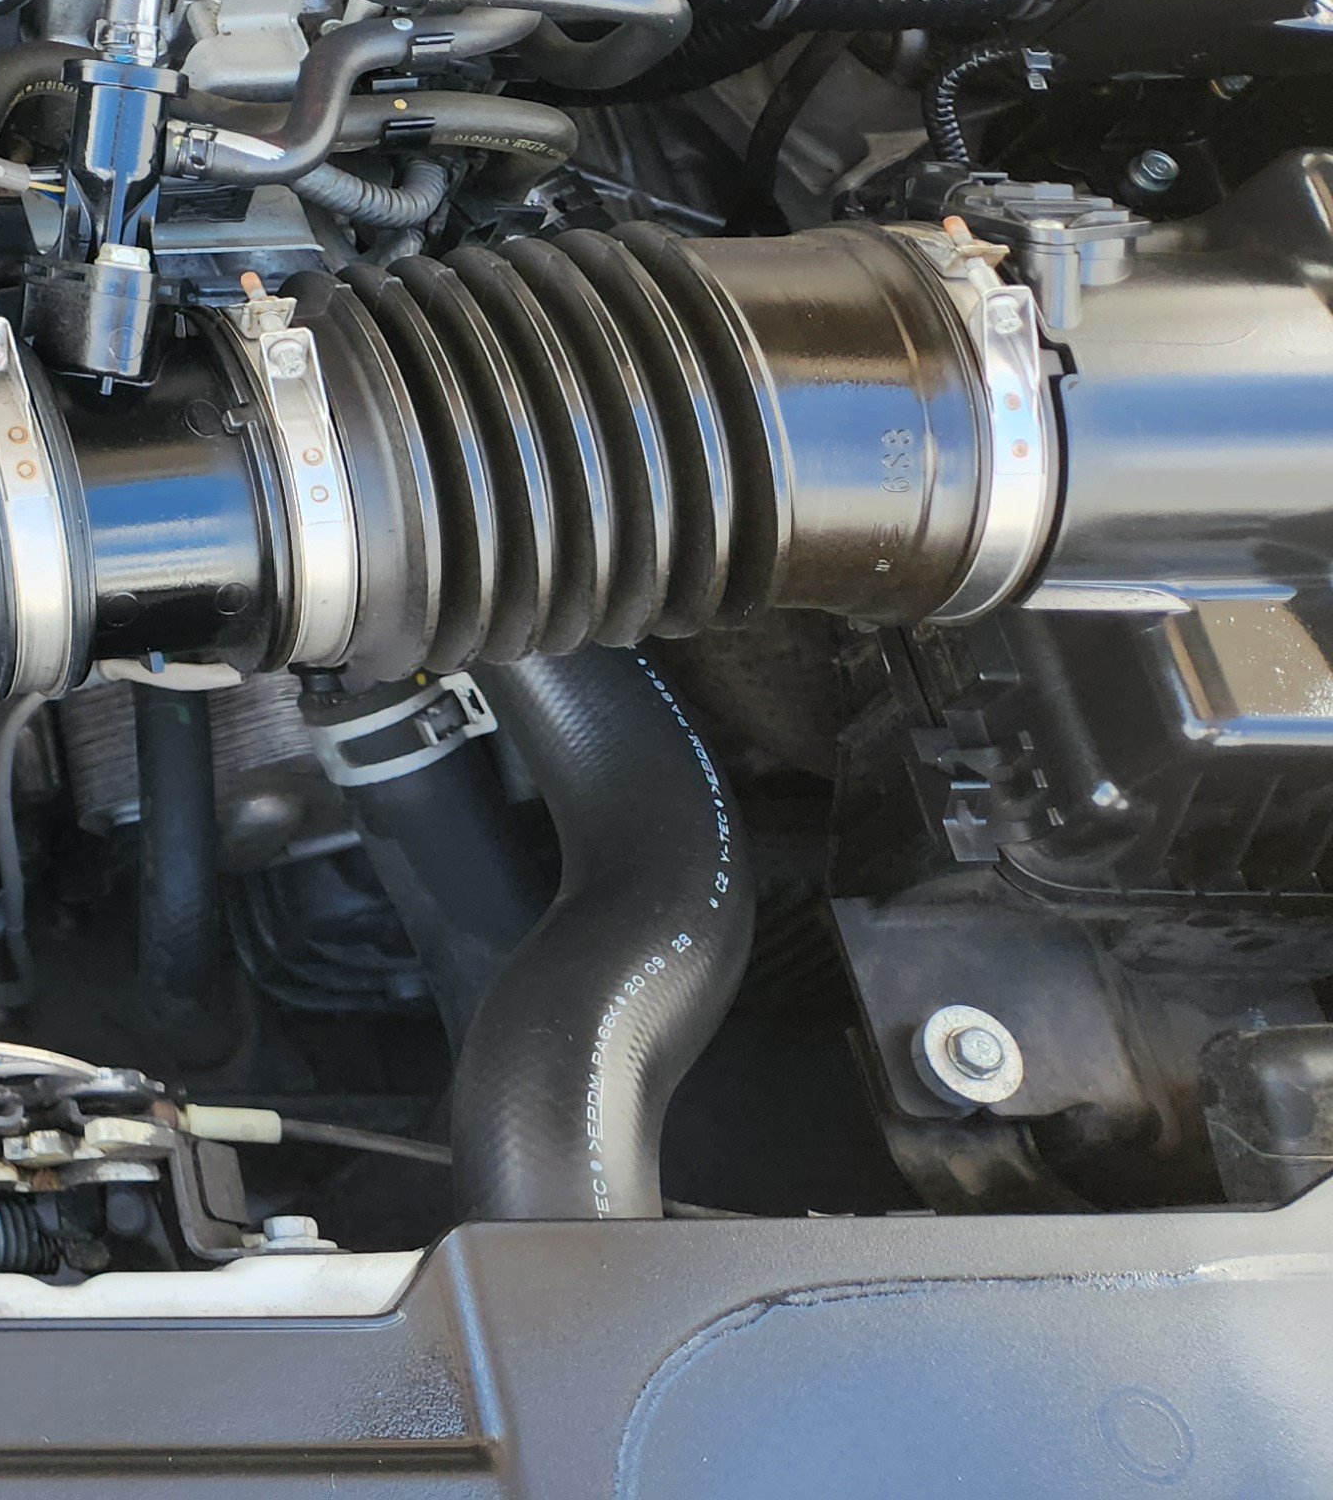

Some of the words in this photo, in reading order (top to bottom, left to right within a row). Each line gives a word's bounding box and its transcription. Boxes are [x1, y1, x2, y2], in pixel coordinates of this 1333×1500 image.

[715, 810, 731, 863] Y-TEC
[715, 871, 730, 894] C2
[623, 974, 646, 996] 20
[643, 955, 666, 976] 09
[671, 932, 694, 954] 28
